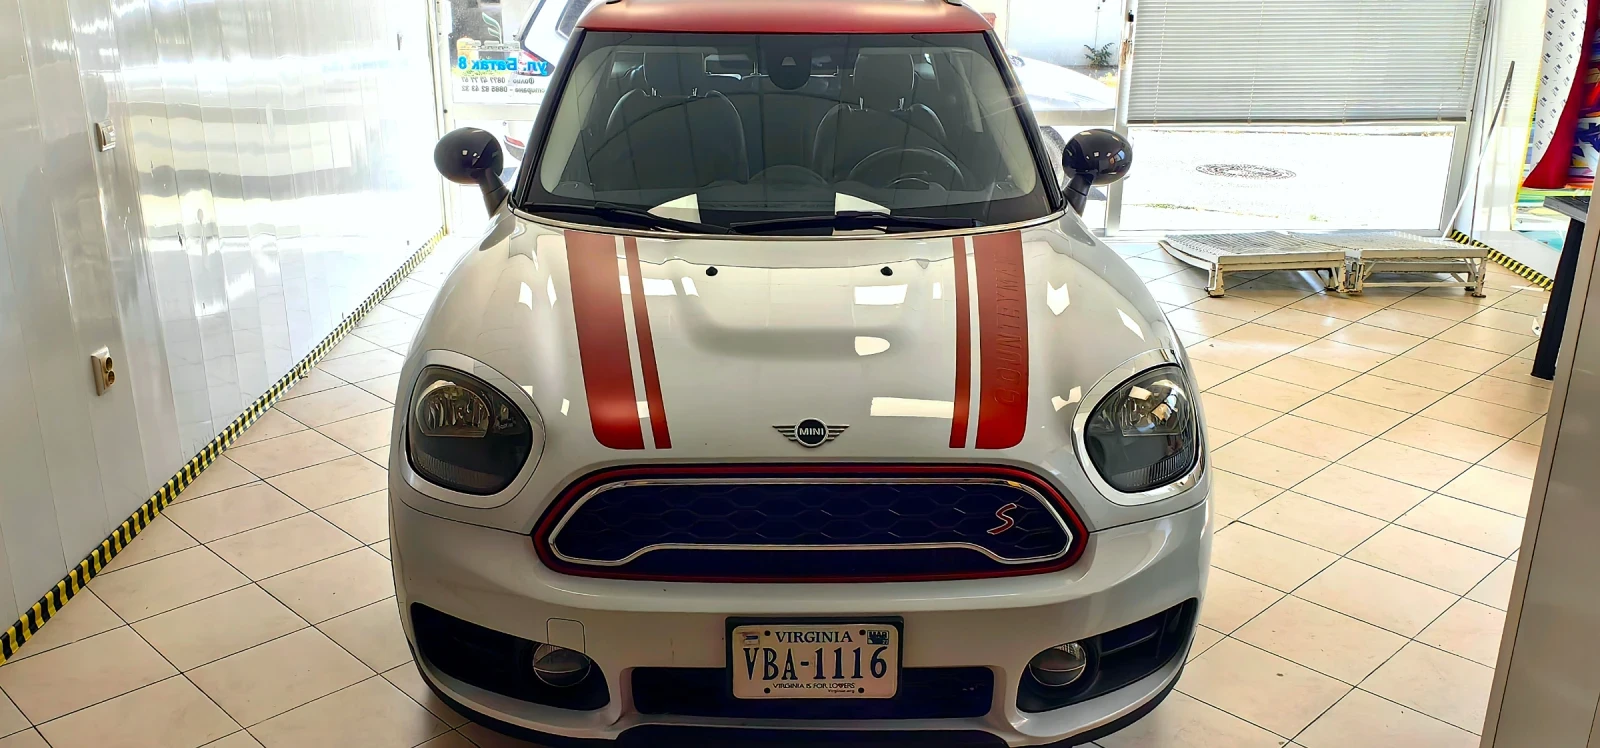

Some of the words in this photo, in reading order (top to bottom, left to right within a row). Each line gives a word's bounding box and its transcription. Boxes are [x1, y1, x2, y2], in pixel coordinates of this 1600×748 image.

[799, 427, 824, 436] MINI
[987, 503, 1017, 535] S
[775, 631, 854, 643] VIRGINIA
[743, 646, 888, 680] VBA-1116
